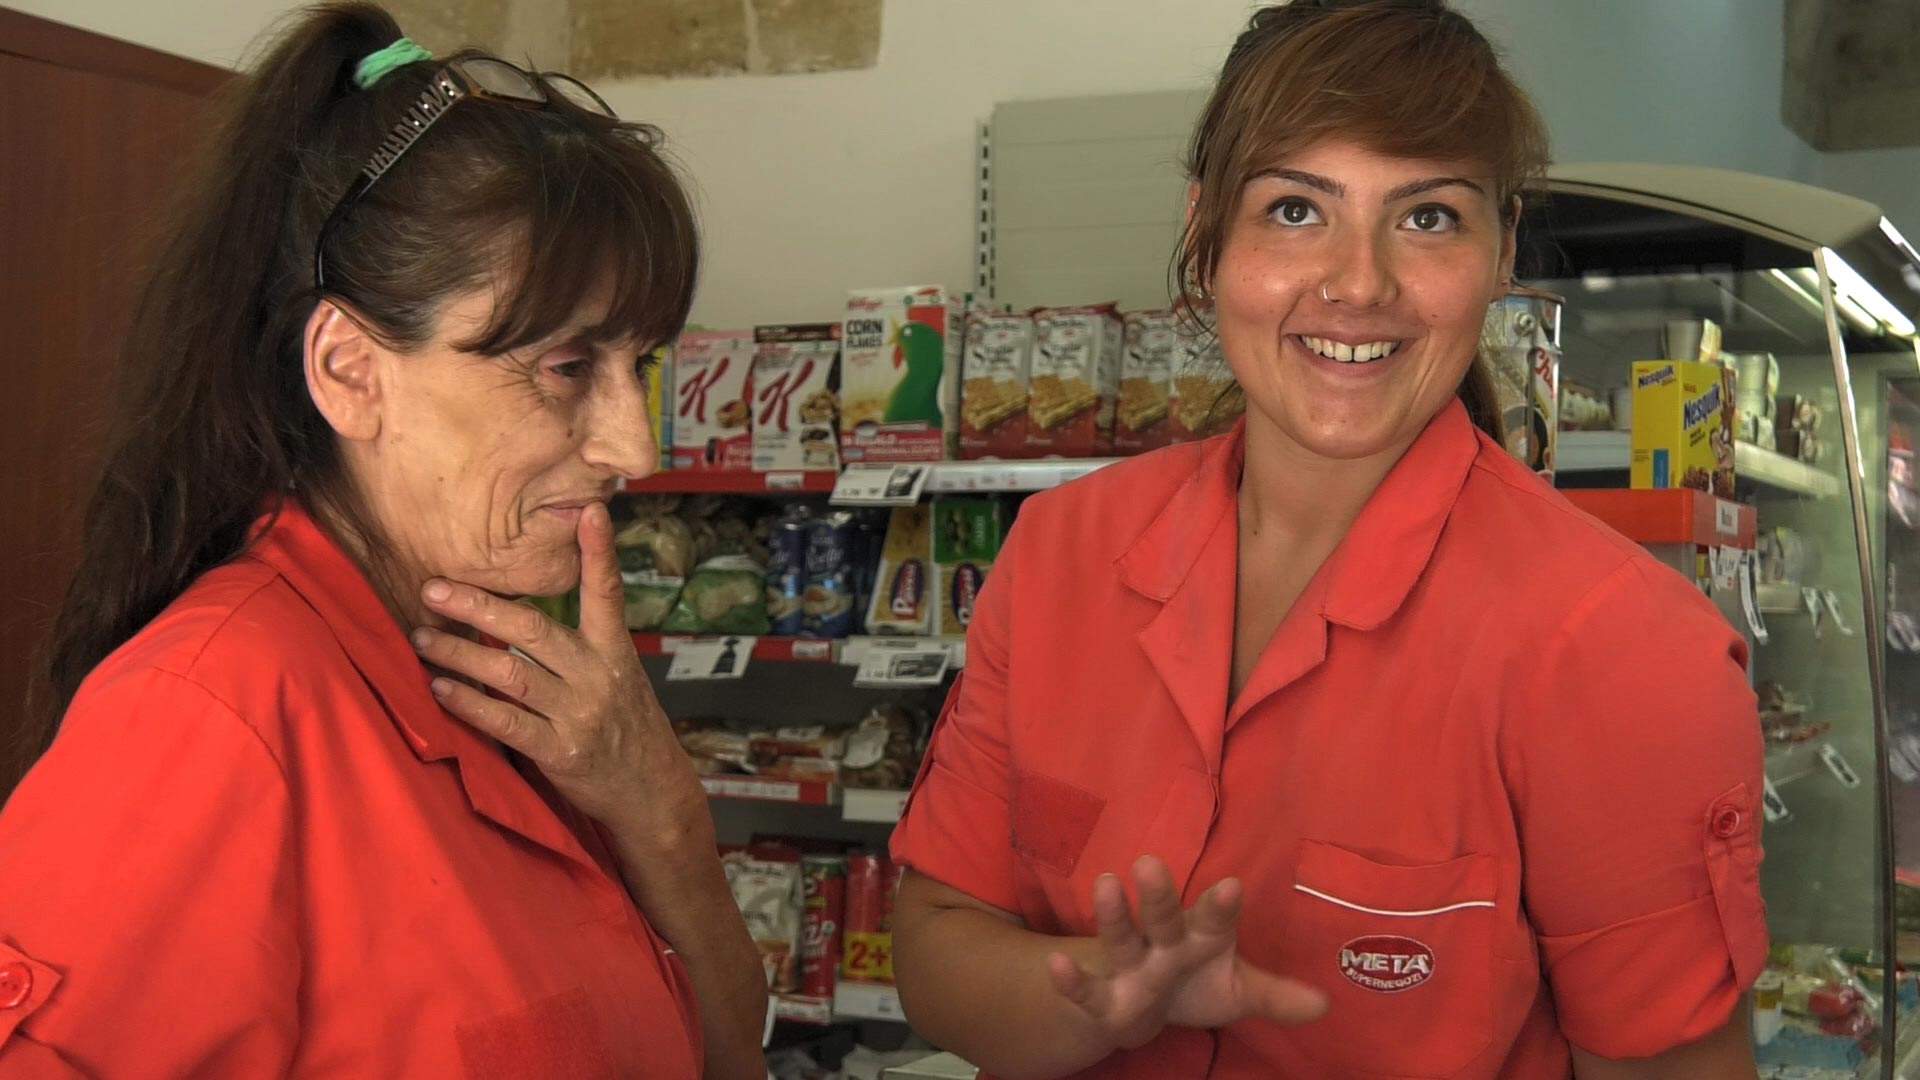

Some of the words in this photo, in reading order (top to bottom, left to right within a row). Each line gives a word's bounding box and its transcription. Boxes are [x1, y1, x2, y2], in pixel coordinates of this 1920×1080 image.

[846, 318, 883, 334] CORN
[847, 335, 883, 348] FLAKES
[1638, 365, 1674, 388] Nesquik
[679, 356, 730, 425] K
[759, 359, 815, 433] K
[1684, 382, 1720, 430] Nesquik
[1341, 948, 1430, 974] META
[1345, 967, 1423, 989] SUPERNEGOZI
